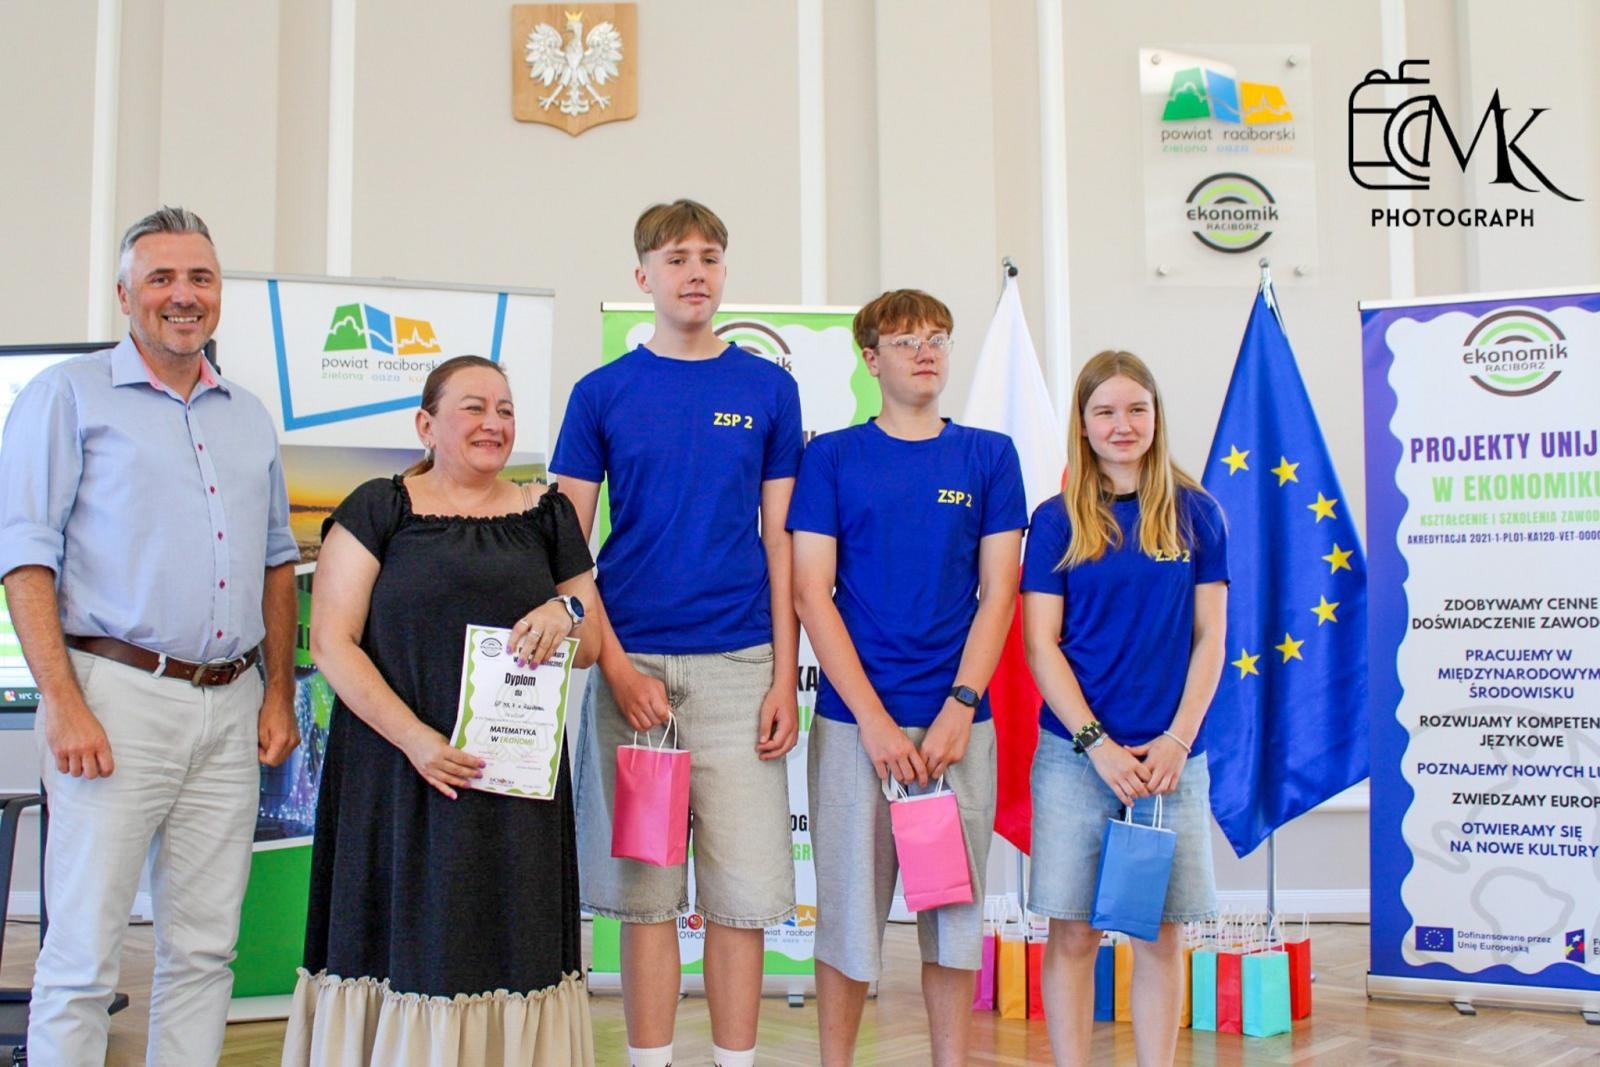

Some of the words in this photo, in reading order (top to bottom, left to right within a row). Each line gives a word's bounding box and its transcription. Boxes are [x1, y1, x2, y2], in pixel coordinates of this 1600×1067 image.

[1161, 128, 1212, 143] powiat
[1223, 127, 1296, 141] raciborski
[1186, 206, 1279, 221] ekonomik
[1463, 344, 1568, 364] ekonomik
[321, 357, 368, 372] powiat
[378, 357, 442, 371] raciborsk
[321, 371, 363, 381] zielona
[713, 412, 741, 426] ZSP
[744, 416, 753, 429] 2
[1410, 433, 1530, 463] PROJEKTY
[1432, 476, 1453, 502] W
[937, 489, 965, 504] ZSP
[965, 493, 972, 507] 2
[1500, 512, 1557, 524] SZKOLENIA
[1407, 534, 1467, 544] AKREDYTACJA
[1182, 549, 1190, 562] 2
[1444, 599, 1543, 611] ZDOBYWAMY
[1547, 597, 1598, 610] CENNE
[1412, 614, 1536, 630] DOŚWIADCZENIE
[1466, 649, 1553, 661] PRACUJEMY
[1556, 649, 1572, 661] W
[504, 672, 536, 686] Dyplom
[1438, 668, 1600, 683] MIĘDZYNARODOWYM
[1469, 683, 1575, 699] ŚRODOWISKU
[1420, 715, 1512, 728] ROZWIJAMY
[490, 726, 536, 736] MATEMATYKA
[1480, 734, 1564, 750] JĘZYKOWE
[1417, 763, 1508, 776] POZNAJEMY
[1512, 765, 1584, 778] NOWYCH
[1452, 793, 1546, 807] ZWIEDZAMY
[1461, 822, 1555, 838] OTWIERAMY
[1560, 825, 1582, 842] SIĘ
[1450, 841, 1472, 853] NA
[1477, 842, 1524, 855] NOWE
[1529, 843, 1599, 857] KULTURY
[1457, 930, 1525, 942] Dofinansowane
[1479, 942, 1529, 953] Europejską
